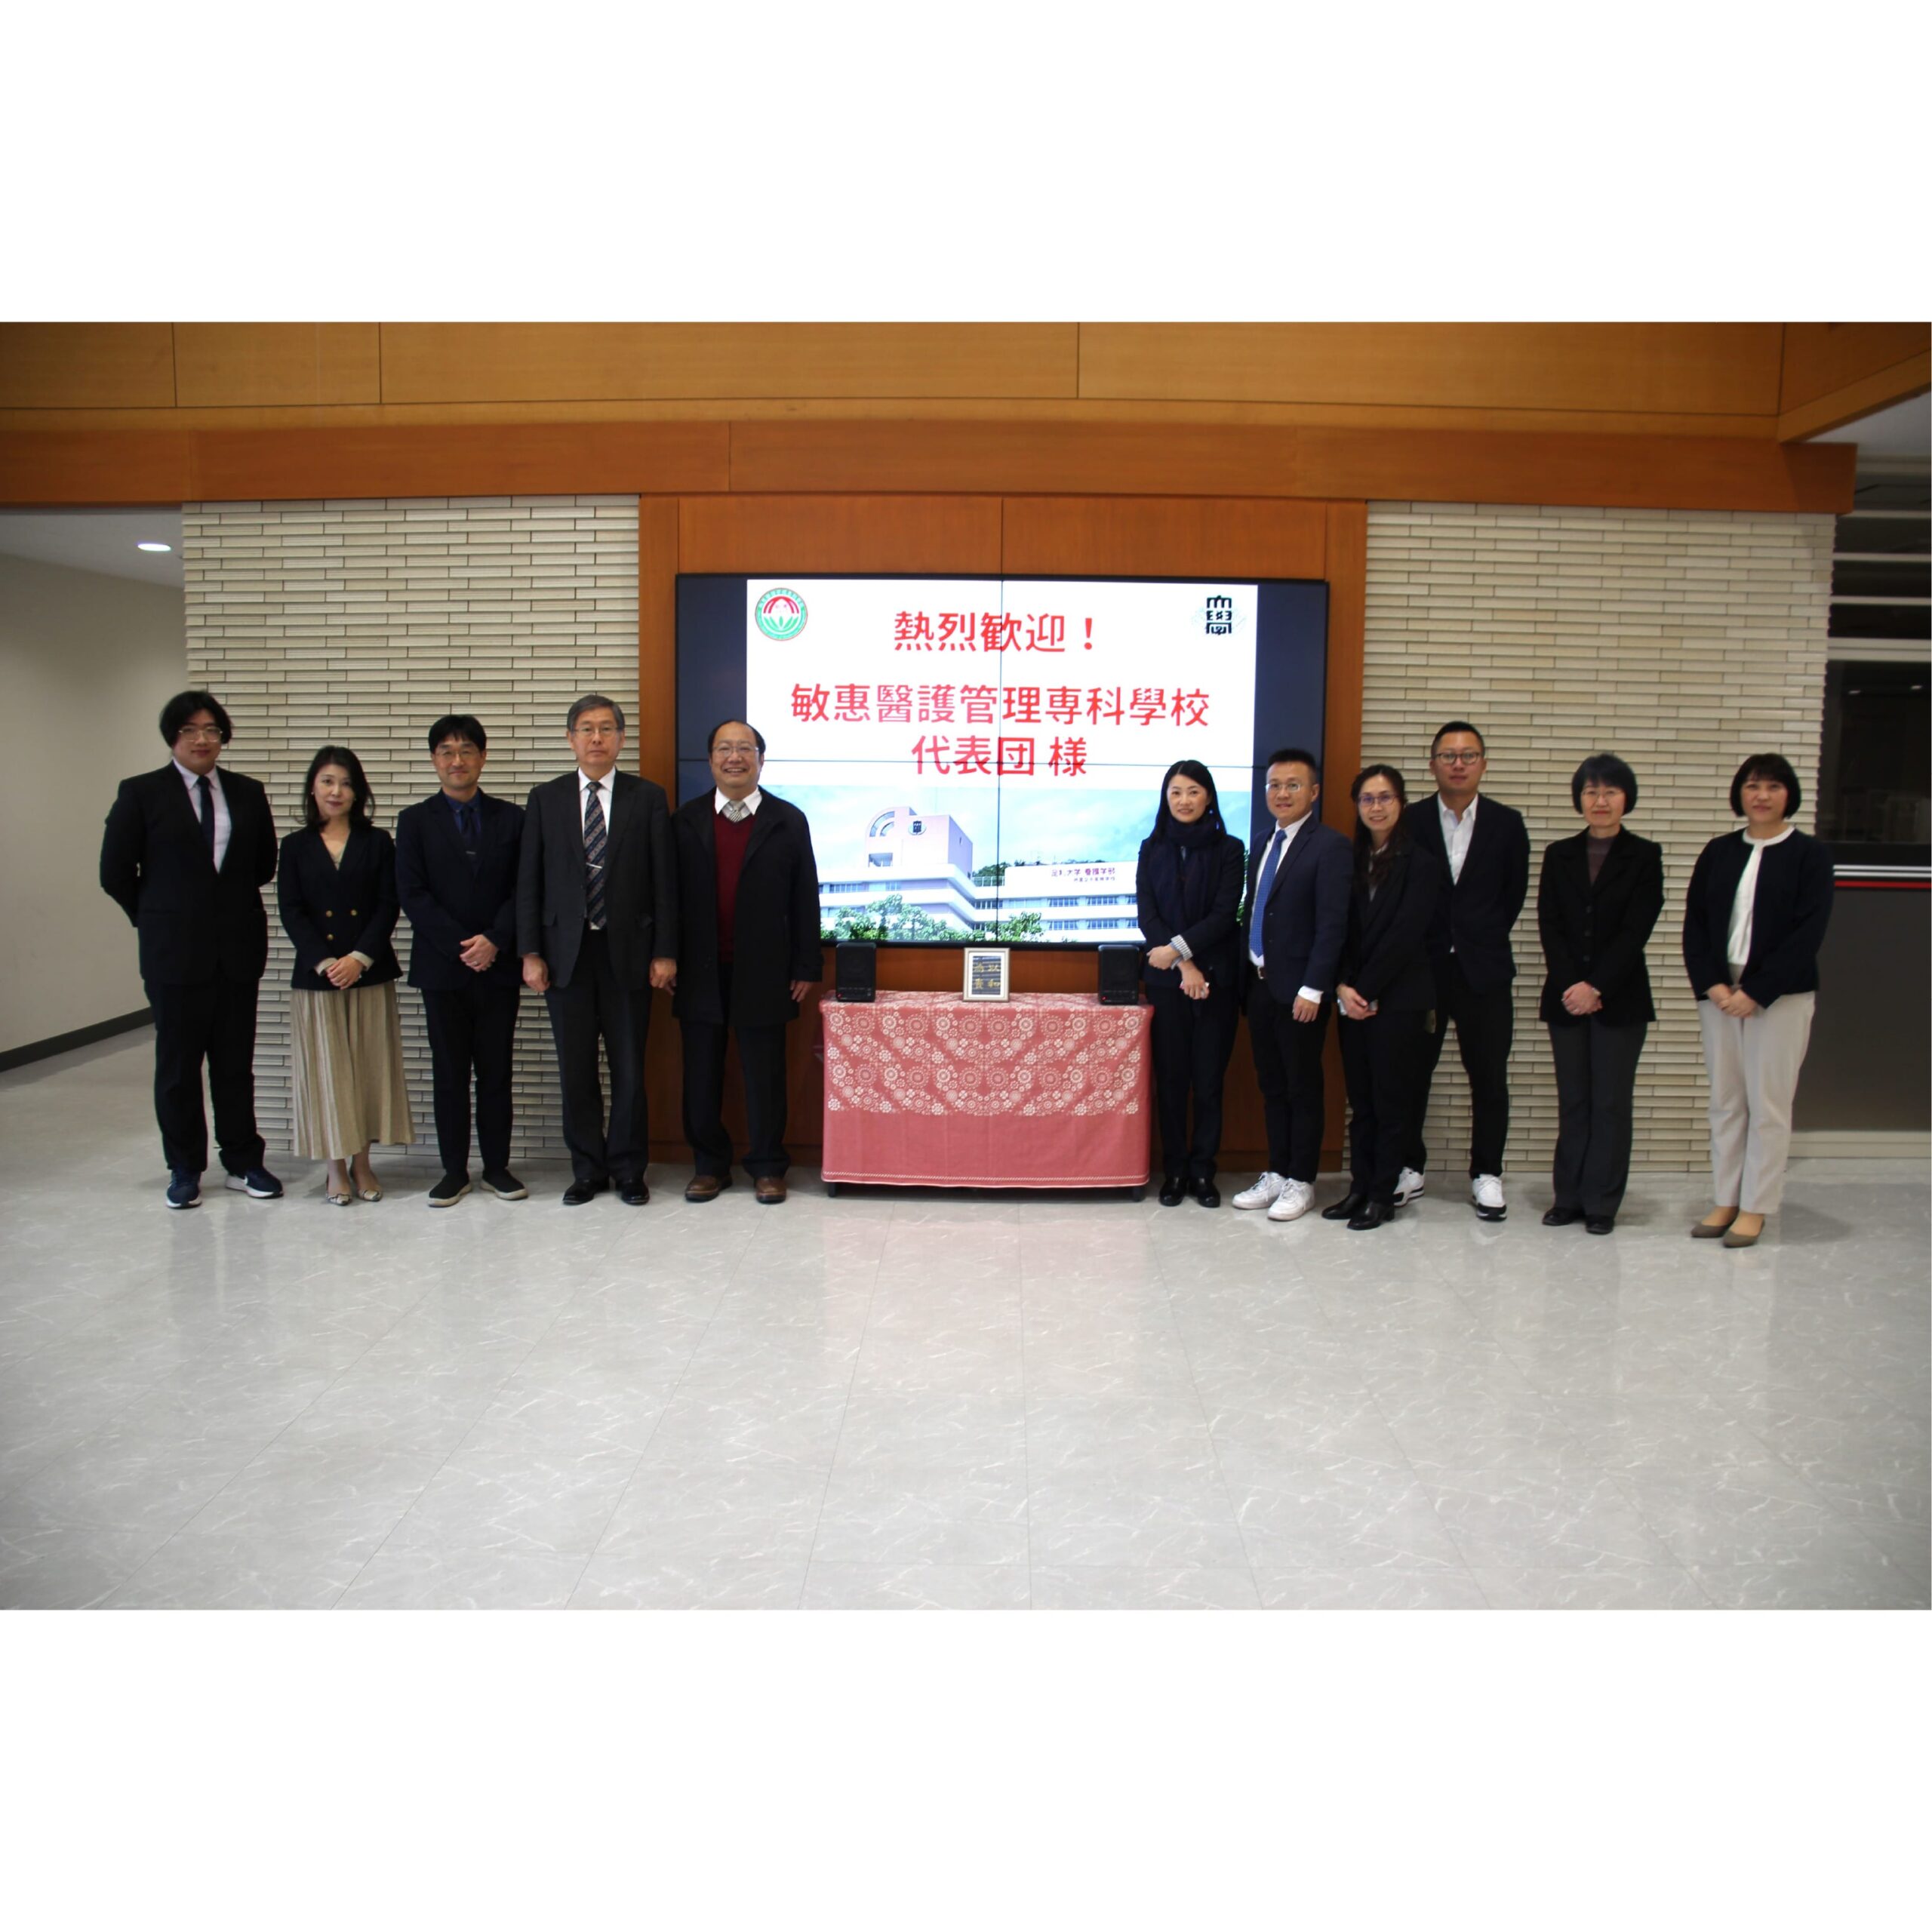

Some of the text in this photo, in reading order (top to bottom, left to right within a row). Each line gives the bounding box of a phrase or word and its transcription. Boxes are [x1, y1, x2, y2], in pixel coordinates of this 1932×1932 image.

[894, 611, 1092, 652] 熱烈歓迎！
[791, 683, 1209, 726] 敏惠醫護管理専科學校
[912, 735, 1087, 777] 代表団 様
